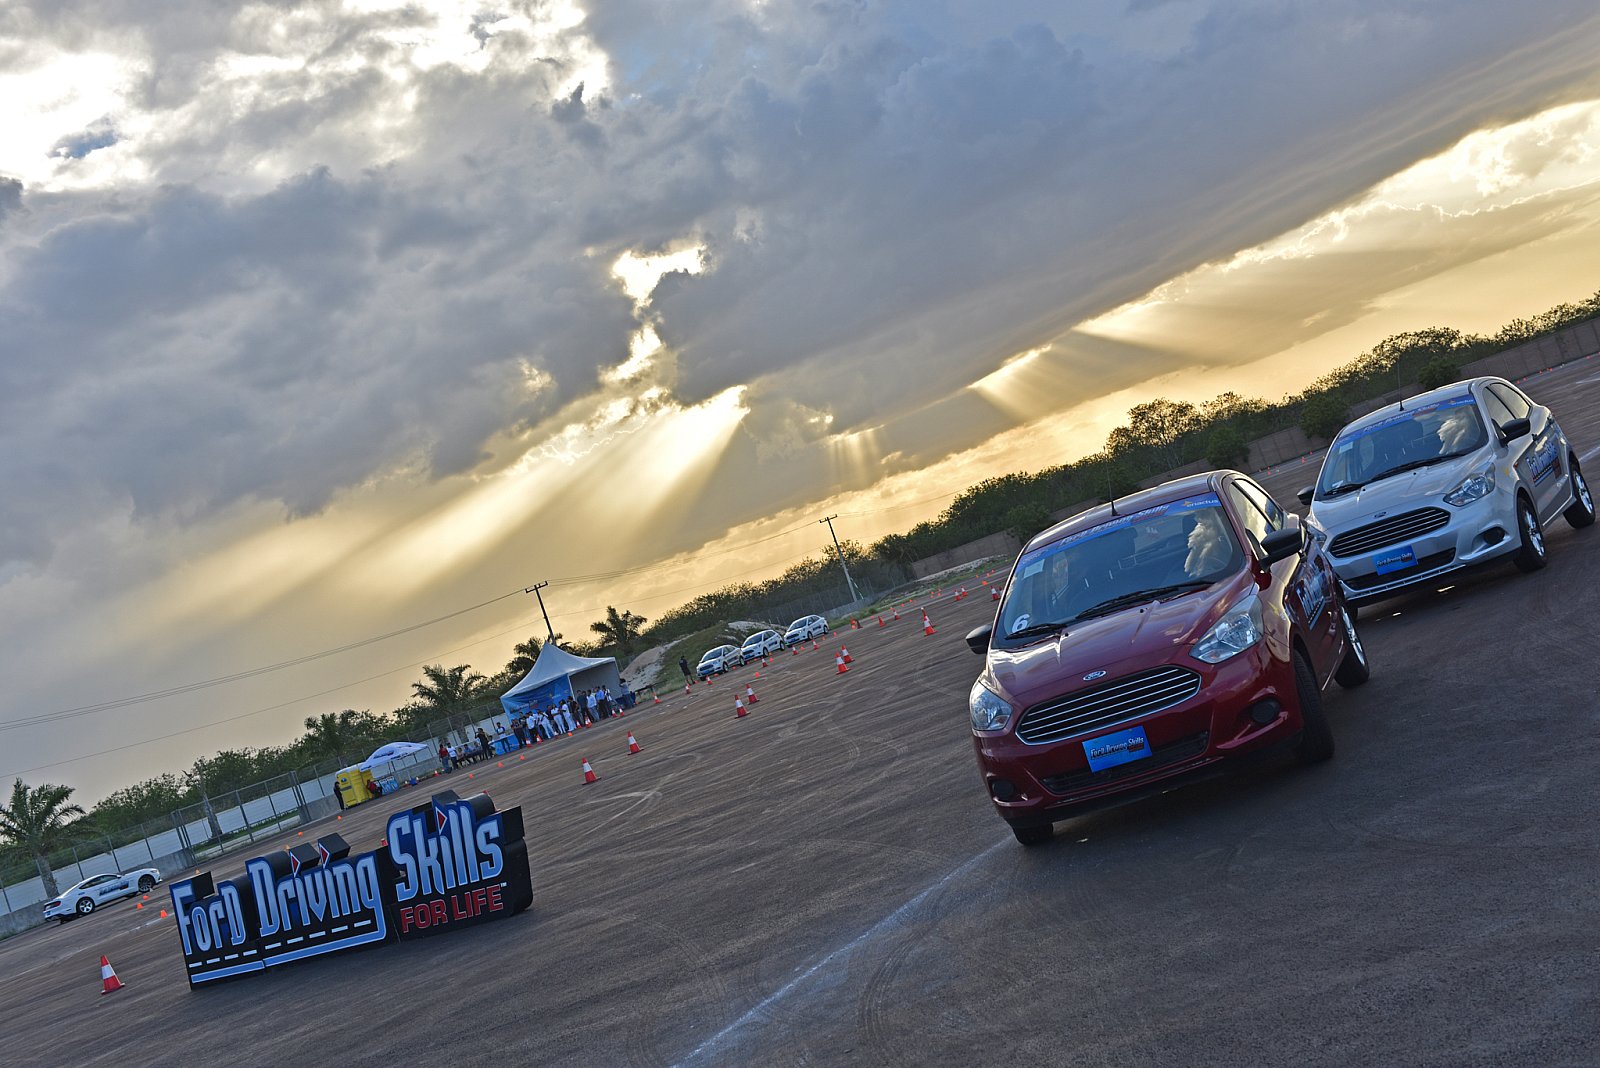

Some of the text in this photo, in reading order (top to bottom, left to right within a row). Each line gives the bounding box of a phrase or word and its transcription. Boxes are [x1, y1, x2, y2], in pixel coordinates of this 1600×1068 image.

[247, 844, 386, 940] Driving
[388, 805, 504, 903] Skills
[400, 898, 448, 933] FOR
